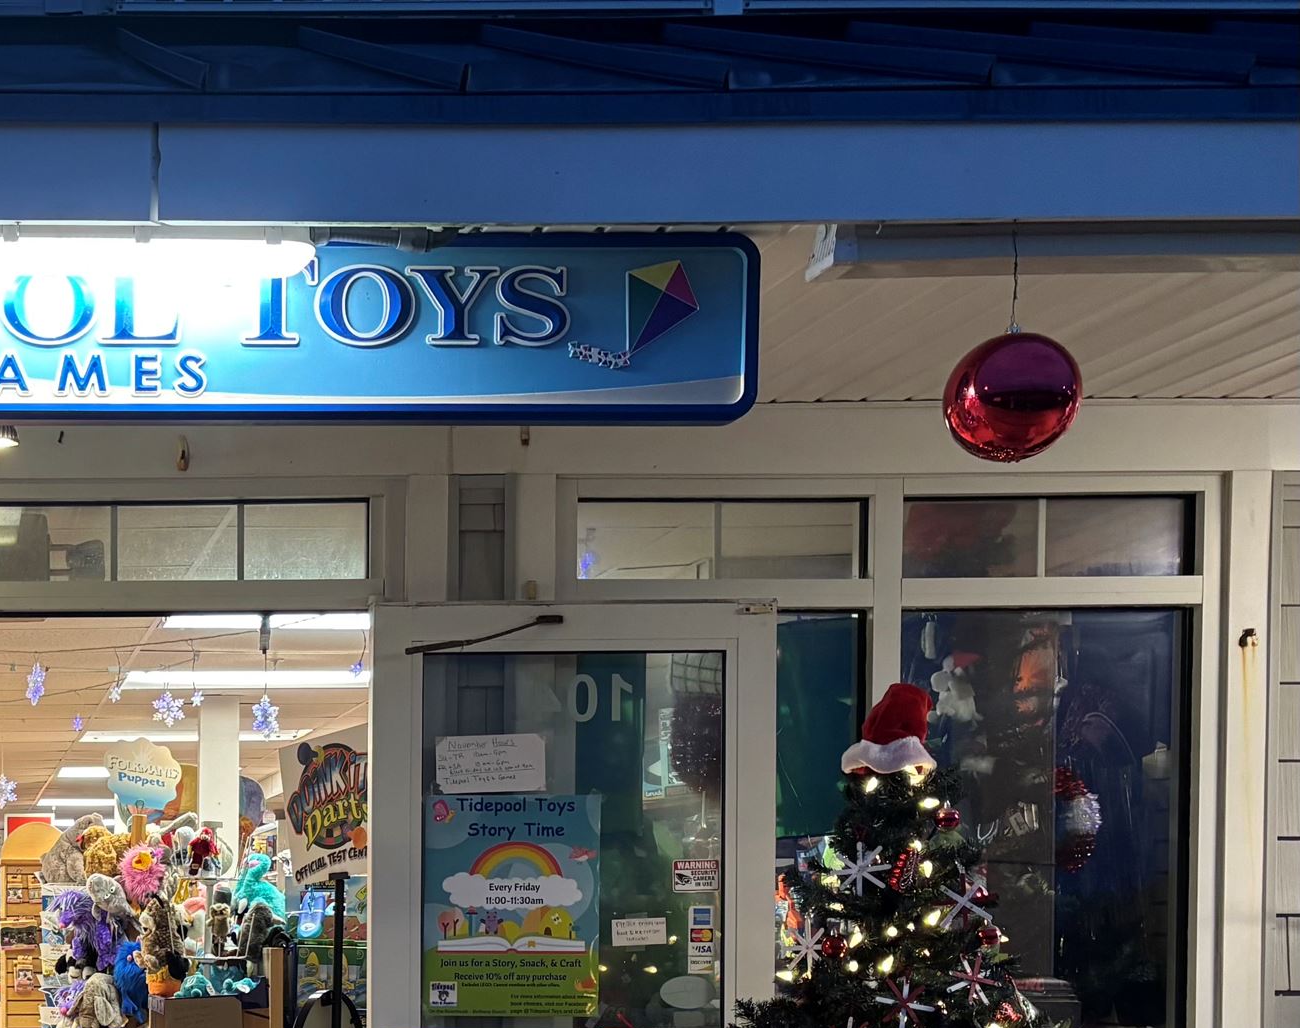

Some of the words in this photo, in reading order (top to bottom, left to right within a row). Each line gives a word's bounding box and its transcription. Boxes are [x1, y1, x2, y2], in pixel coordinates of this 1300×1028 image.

[241, 256, 570, 348] TOYS
[117, 772, 166, 788] Puppets
[456, 797, 526, 816] Tidepool
[535, 798, 576, 816] Toys
[468, 823, 516, 840] Story
[524, 822, 565, 836] Time
[295, 856, 328, 883] OFFICIAL
[327, 848, 348, 864] TEST
[677, 861, 717, 870] WARNING
[489, 883, 512, 893] Every
[514, 883, 541, 893] Friday
[486, 896, 544, 904] 11:00-11:30am
[440, 959, 457, 968] Join
[471, 958, 482, 967] for
[492, 959, 518, 968] Story,
[520, 959, 548, 968] Snack,
[550, 960, 558, 968] &
[560, 959, 582, 968] Craft
[504, 972, 514, 980] off
[532, 973, 567, 982] purchase
